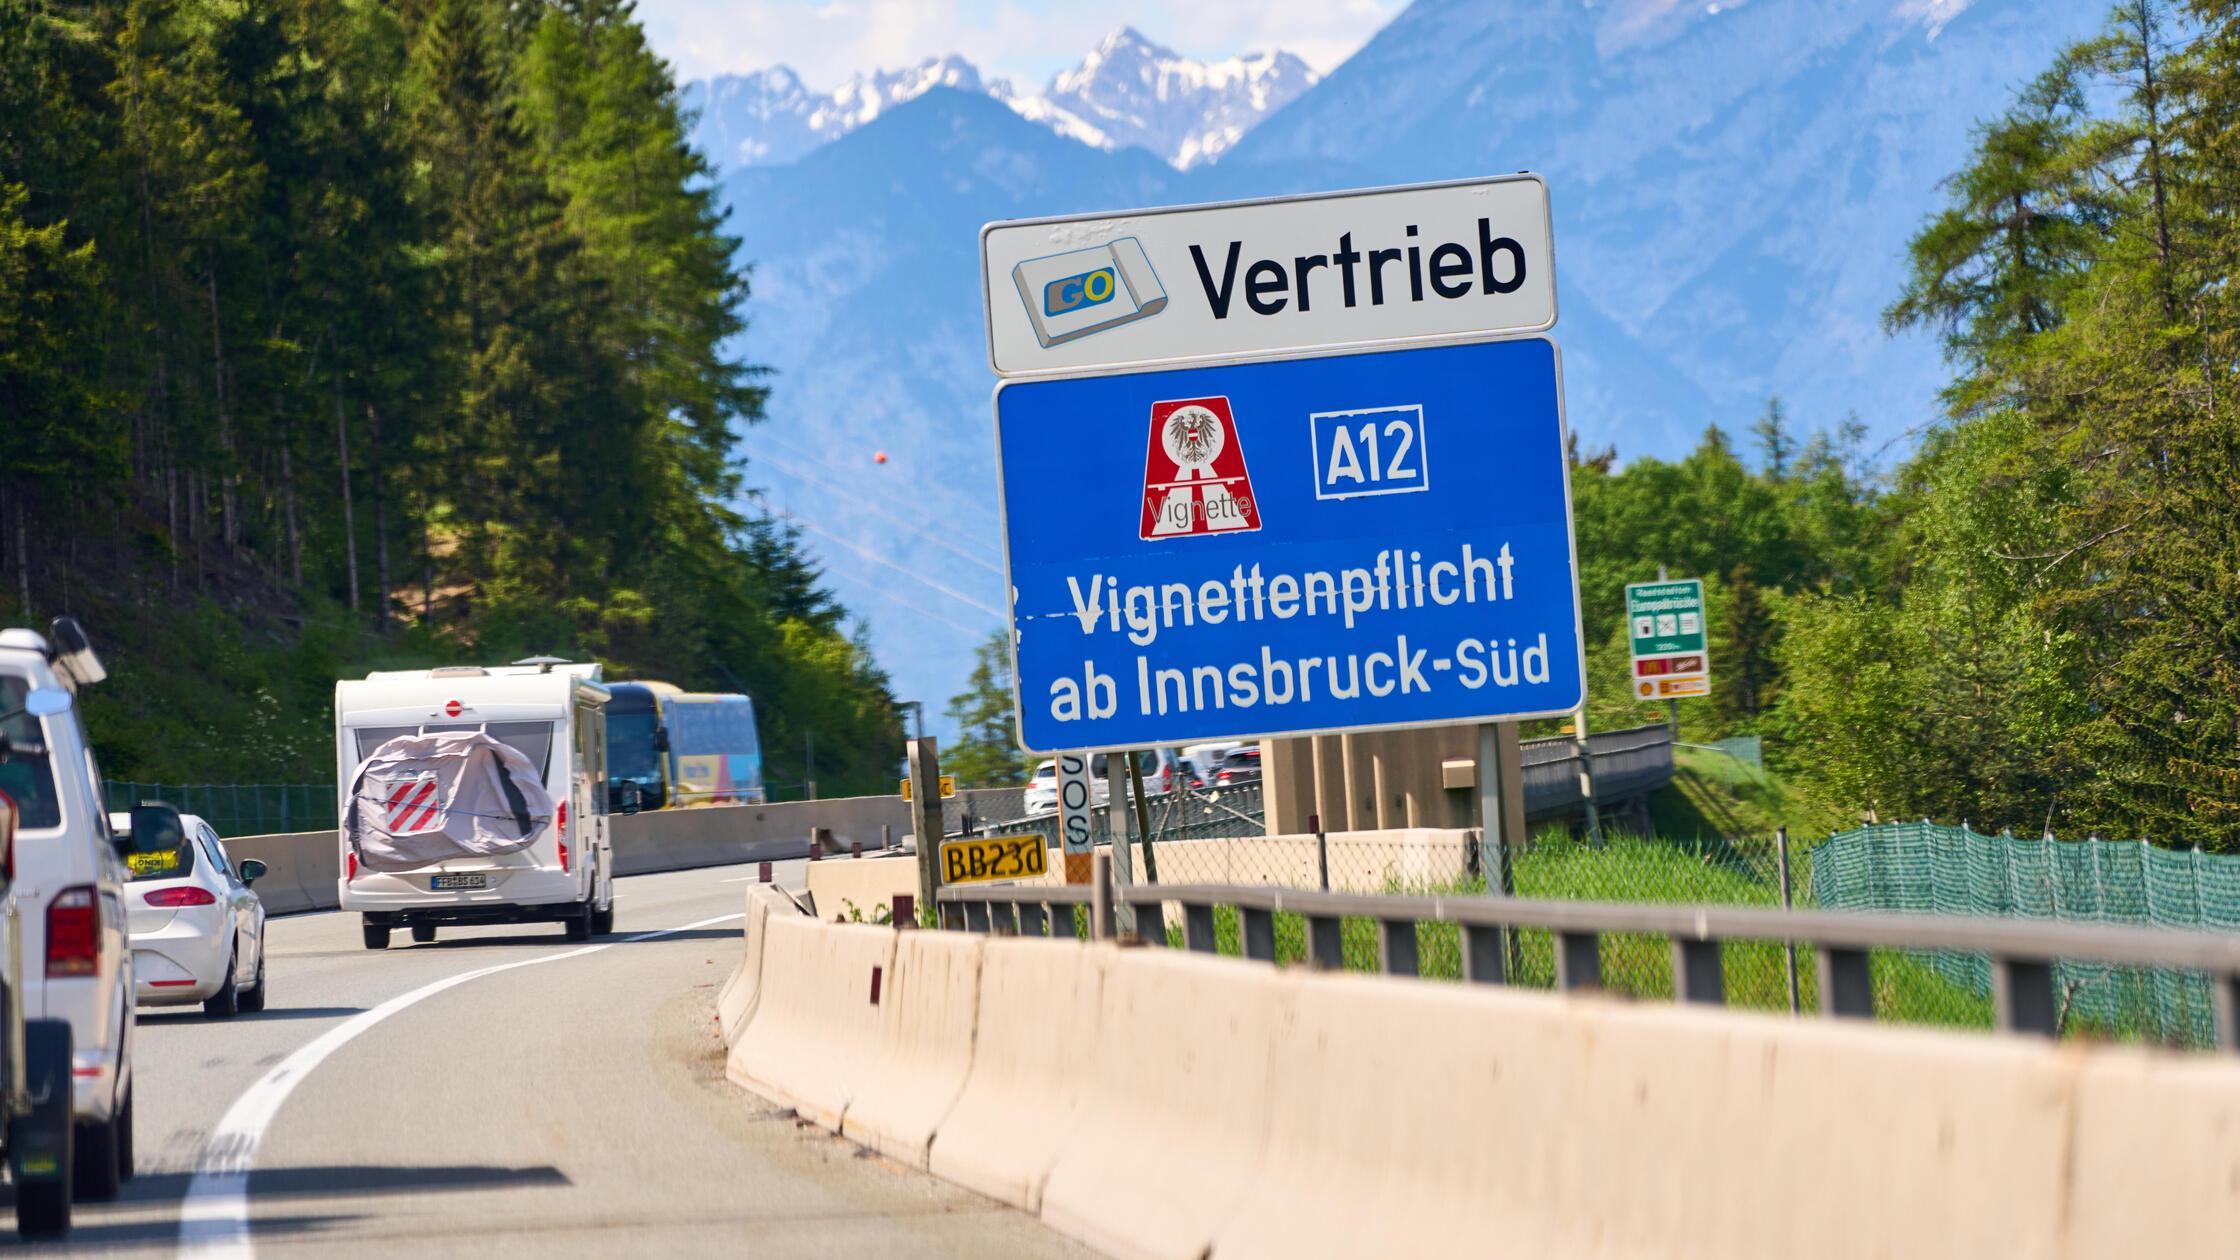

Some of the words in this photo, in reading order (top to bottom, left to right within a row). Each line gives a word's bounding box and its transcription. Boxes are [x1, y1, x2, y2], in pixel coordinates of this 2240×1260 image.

[1047, 270, 1114, 313] GO
[1188, 217, 1527, 320] Vertrieb
[1326, 420, 1417, 485] A12
[1147, 492, 1252, 529] Vignette
[1066, 542, 1514, 647] Vignettenpflicht
[1050, 660, 1117, 722] ab
[1137, 633, 1550, 716] Innsbruck-Süd
[1061, 755, 1090, 845] SOS
[946, 835, 1043, 882] BB23d
